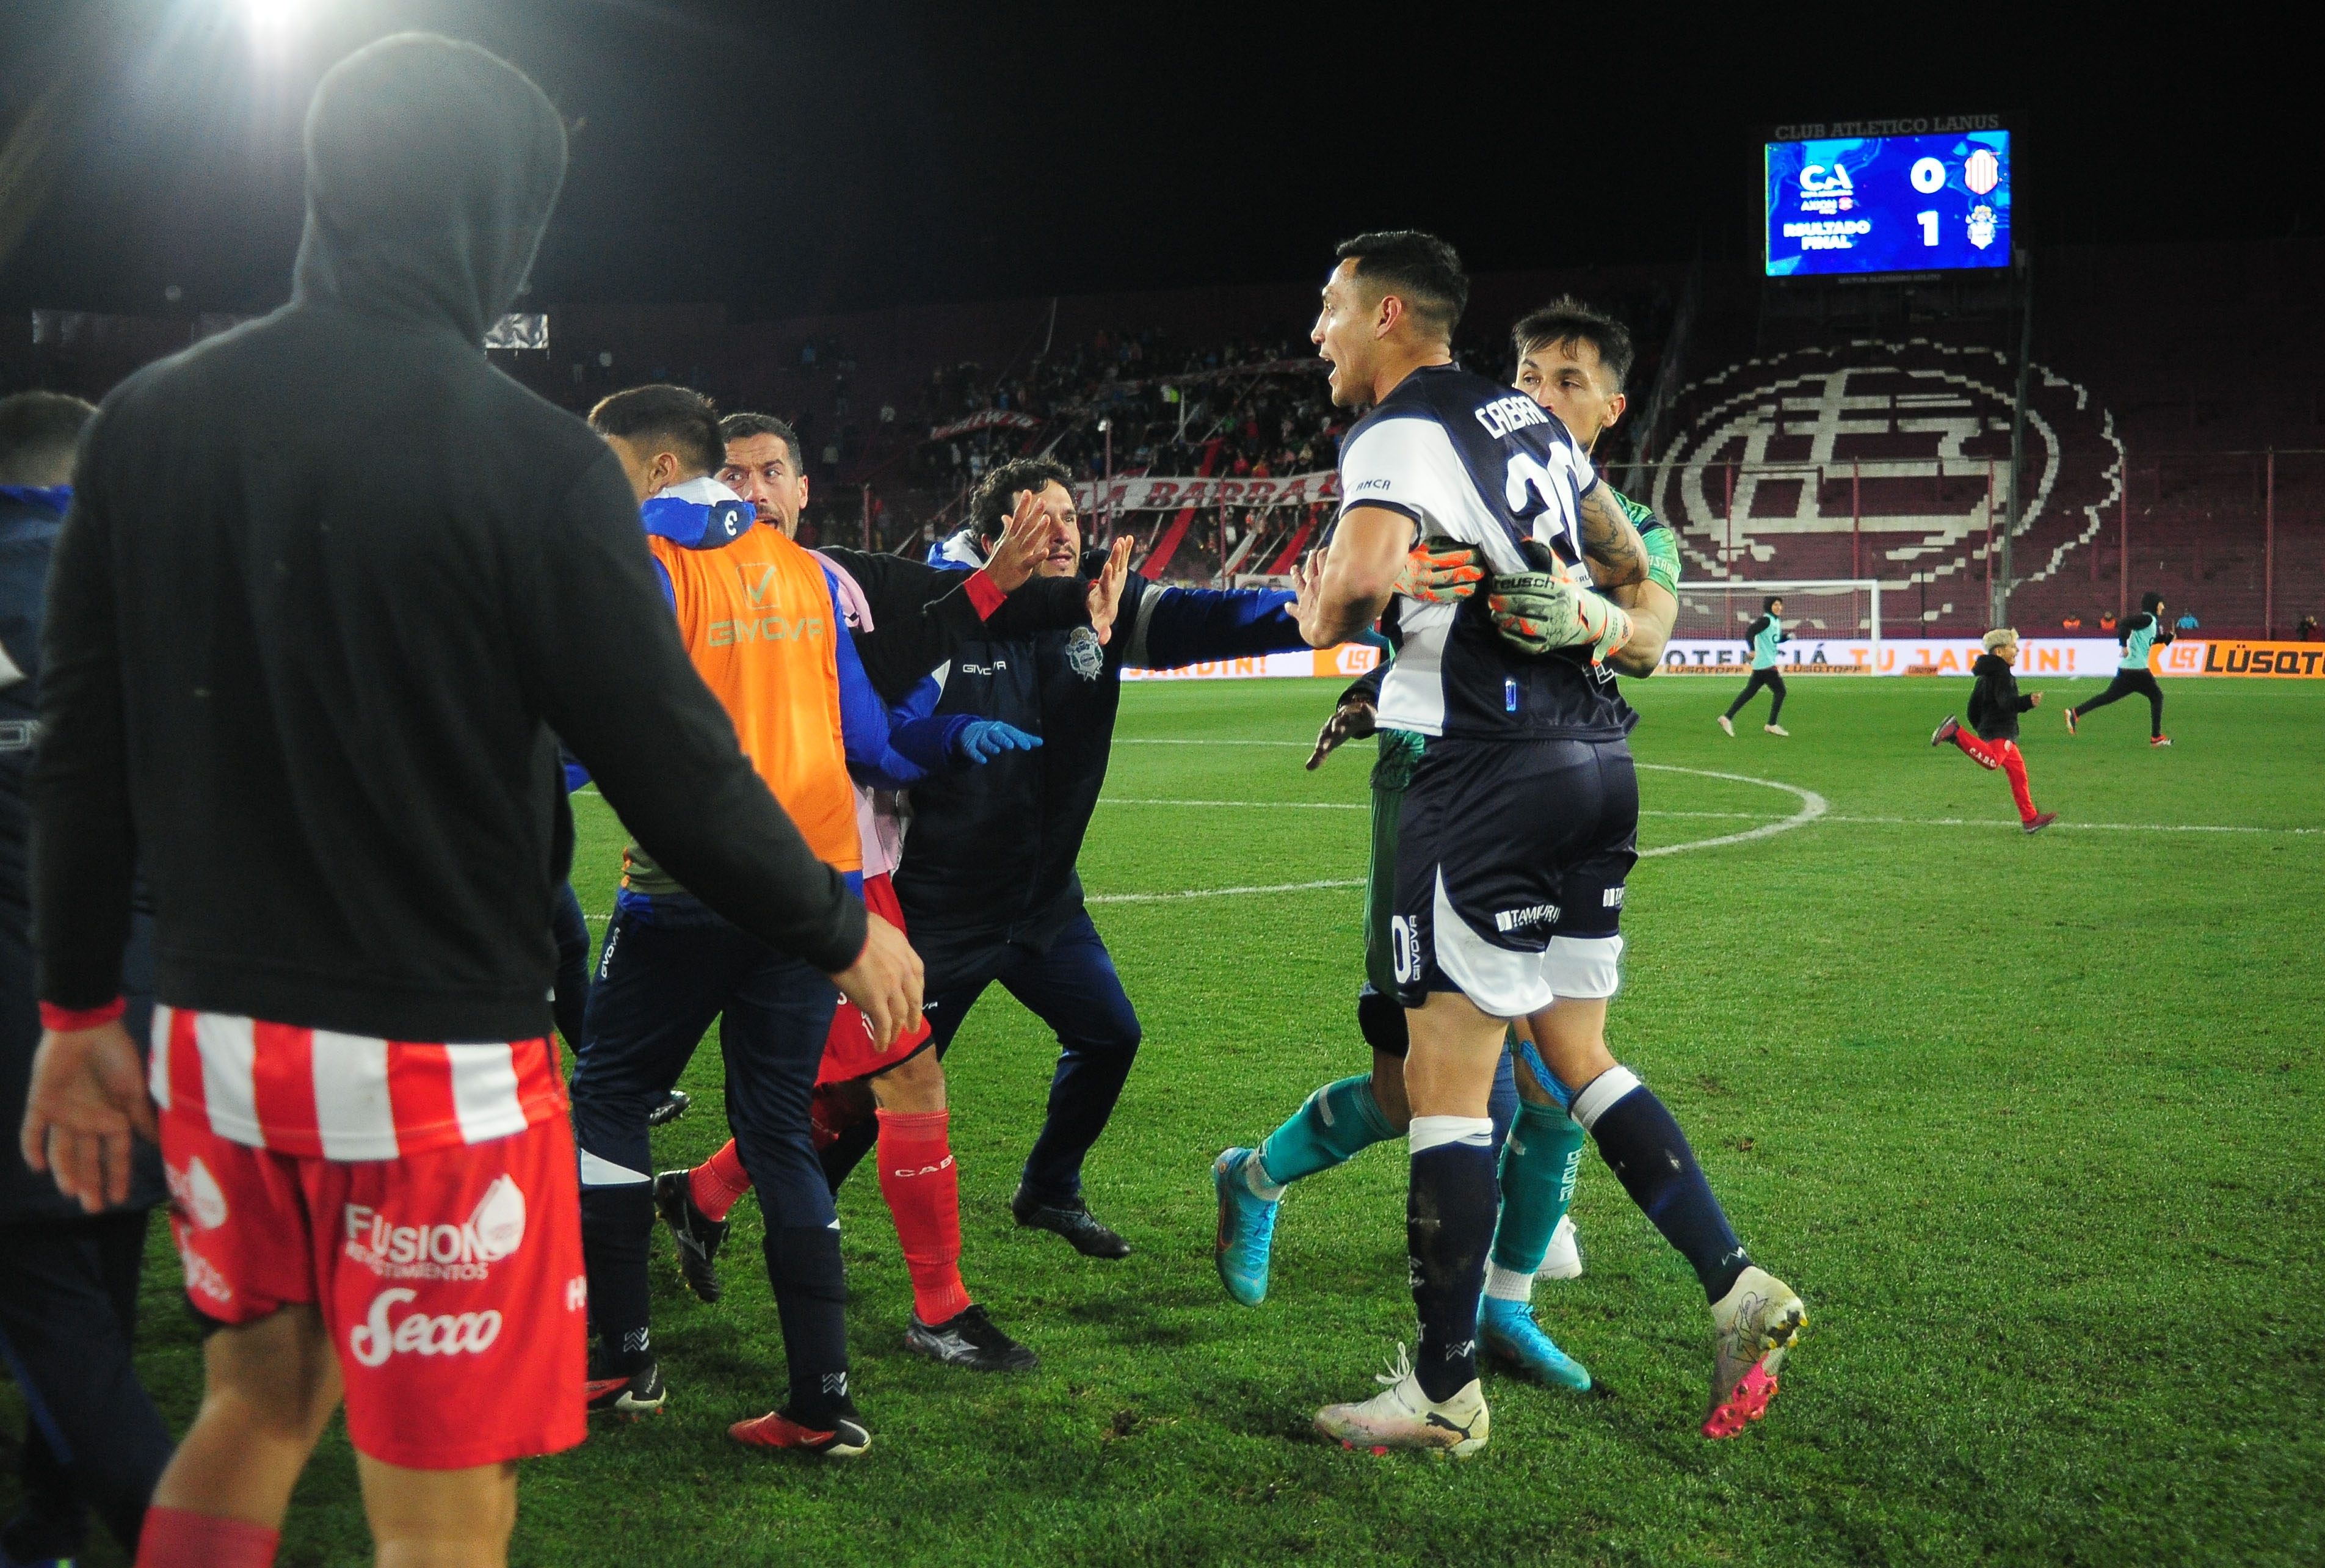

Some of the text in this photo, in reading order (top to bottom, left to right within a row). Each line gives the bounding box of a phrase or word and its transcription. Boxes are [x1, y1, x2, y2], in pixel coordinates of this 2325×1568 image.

[1775, 114, 2000, 140] CLUB ATLETICO LANUS
[1910, 157, 1946, 194] 0
[1917, 210, 1939, 247] 1
[1474, 396, 1549, 440] CABRAL
[1849, 648, 1895, 672] TU
[2204, 644, 2325, 675] LÜSQT
[1409, 915, 1421, 981] GIVOVA
[350, 1287, 502, 1368] Secco
